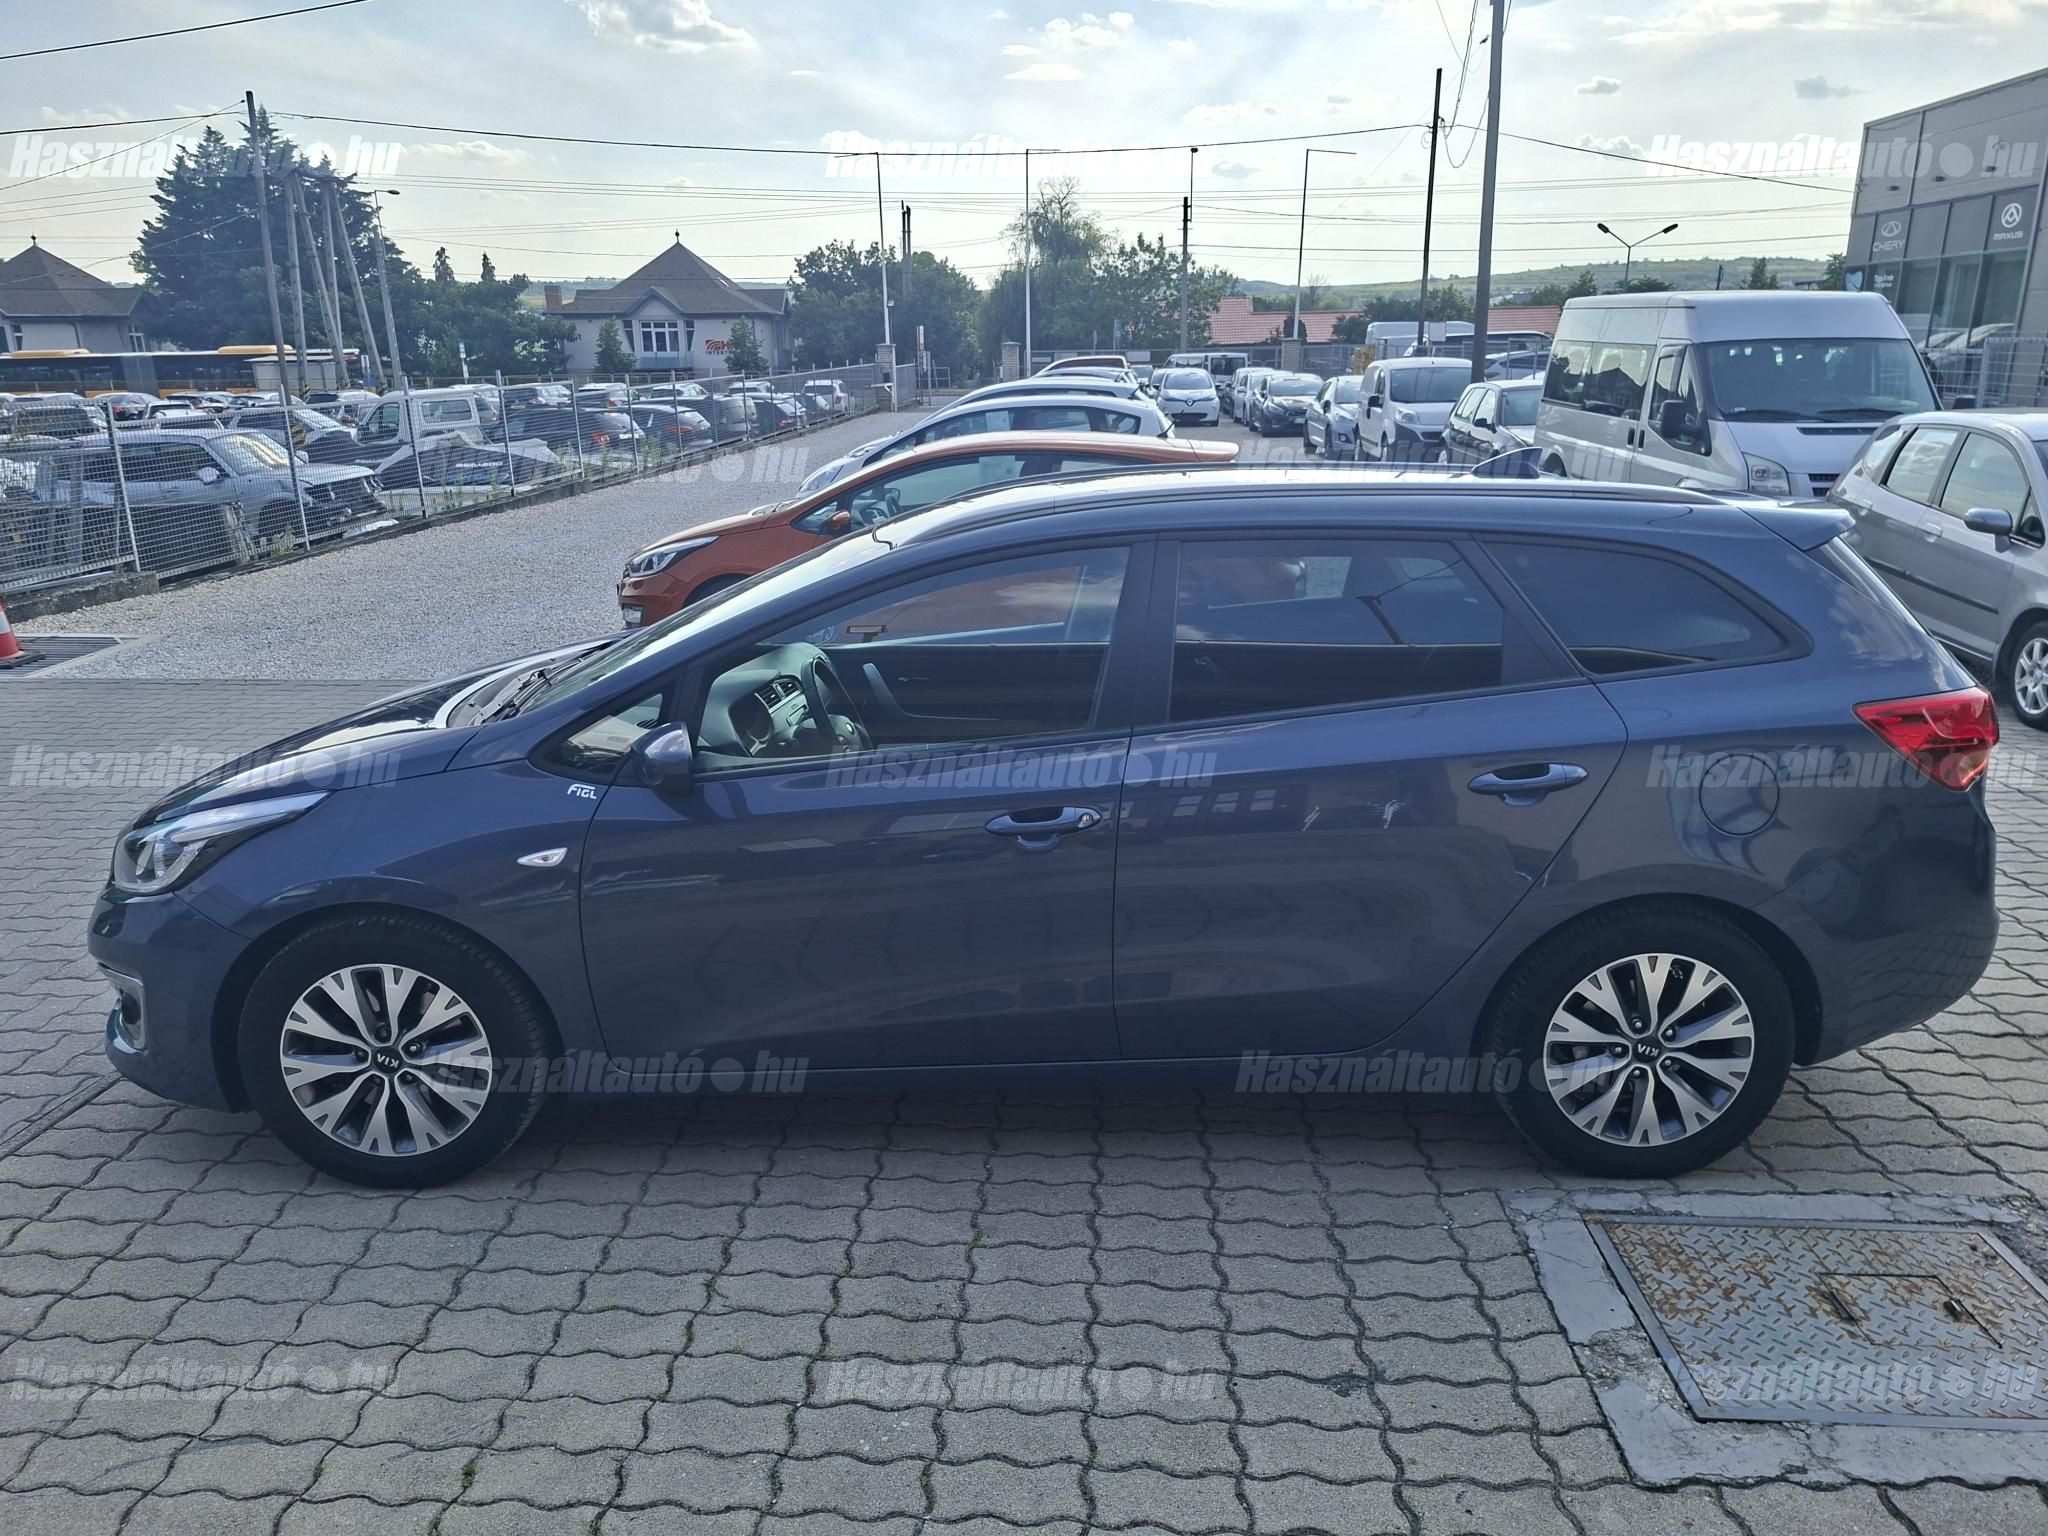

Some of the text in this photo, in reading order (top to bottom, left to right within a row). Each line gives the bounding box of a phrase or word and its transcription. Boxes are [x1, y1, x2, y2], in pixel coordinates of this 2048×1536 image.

[1873, 240, 1906, 252] CHERY
[1637, 1043, 1659, 1057] KIA
[377, 1053, 399, 1068] KIA
